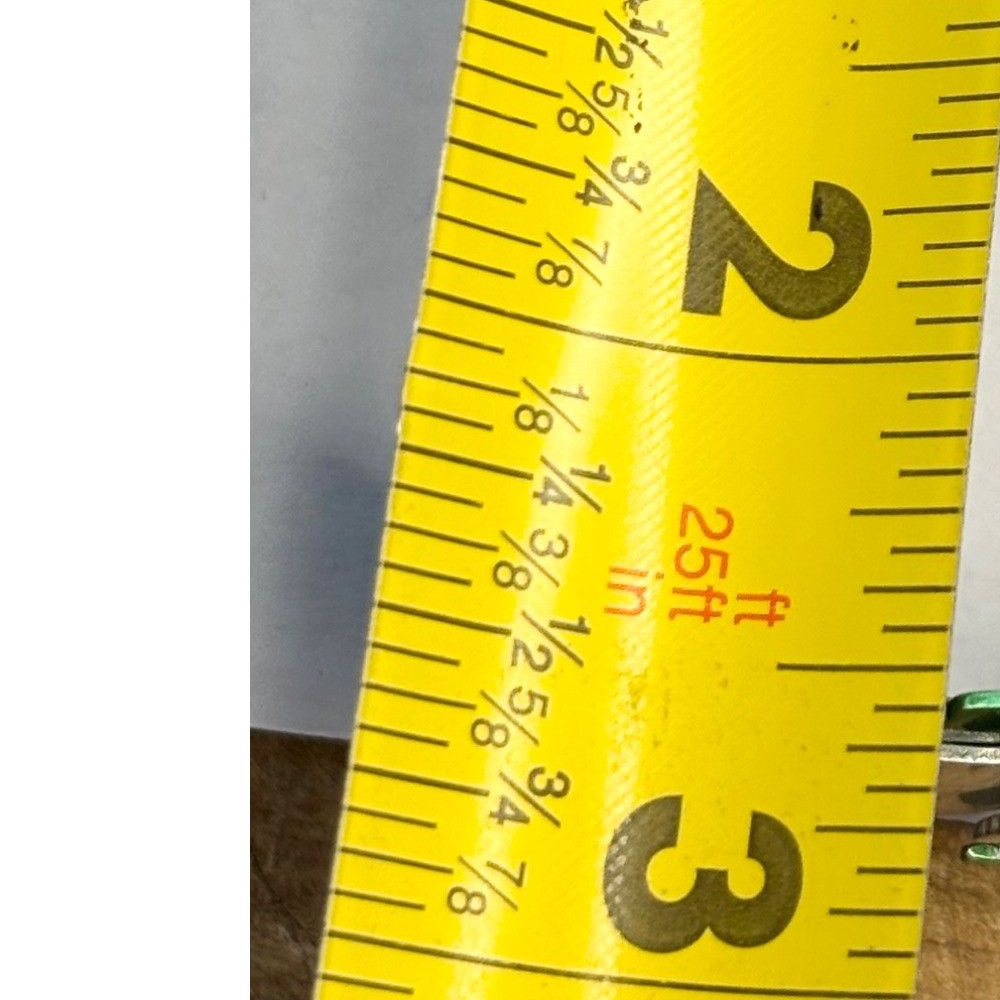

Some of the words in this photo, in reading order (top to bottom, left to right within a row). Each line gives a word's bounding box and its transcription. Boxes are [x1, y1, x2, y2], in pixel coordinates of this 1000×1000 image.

[594, 10, 669, 70] 1/2
[557, 79, 629, 137] 5/8
[575, 155, 652, 213] 3/4
[535, 231, 610, 288] 7/8
[681, 168, 872, 320] 2
[514, 376, 589, 435] 1/8
[533, 455, 611, 514] 1/4
[492, 528, 569, 591] 3/8
[603, 565, 665, 618] in
[733, 589, 791, 628] ft
[510, 611, 591, 673] 1/2
[470, 686, 550, 749] 5/8
[489, 766, 571, 828] 3/4
[446, 855, 527, 917] 7/8
[603, 795, 804, 953] 3
